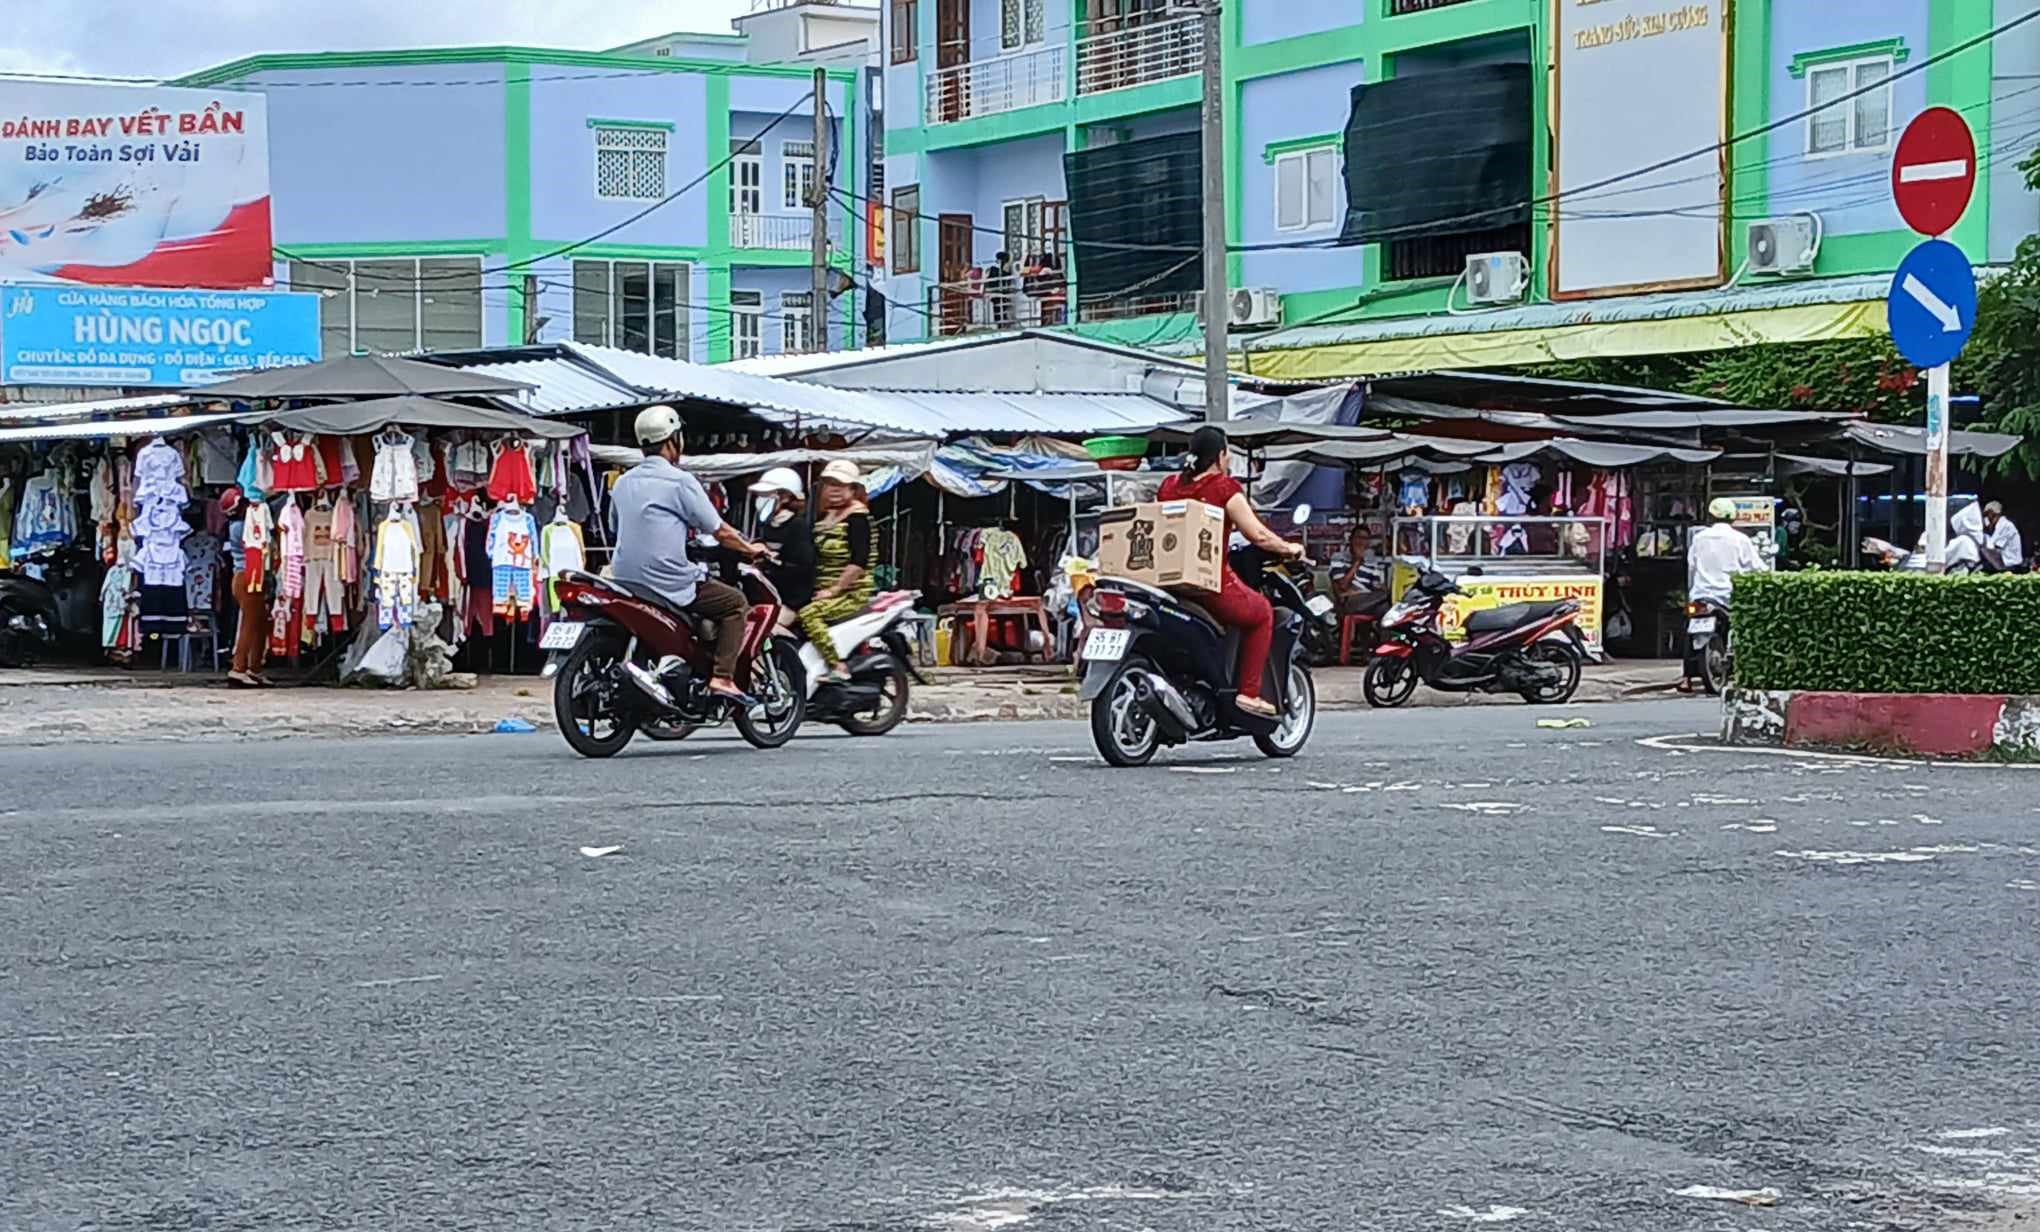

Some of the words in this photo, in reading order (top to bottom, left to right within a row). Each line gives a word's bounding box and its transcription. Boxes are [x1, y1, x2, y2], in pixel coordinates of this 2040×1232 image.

[2, 116, 61, 138] ĐÁNH
[66, 117, 113, 137] BAY
[119, 106, 172, 136] VẾT
[179, 101, 244, 134] BẨN
[25, 142, 59, 161] Bảo
[65, 144, 112, 162] Toàn
[119, 144, 154, 166] Sợi
[163, 140, 200, 162] Vải
[73, 308, 163, 344] HÙNG
[169, 316, 252, 353] NGỌC
[1553, 585, 1596, 599] LINH
